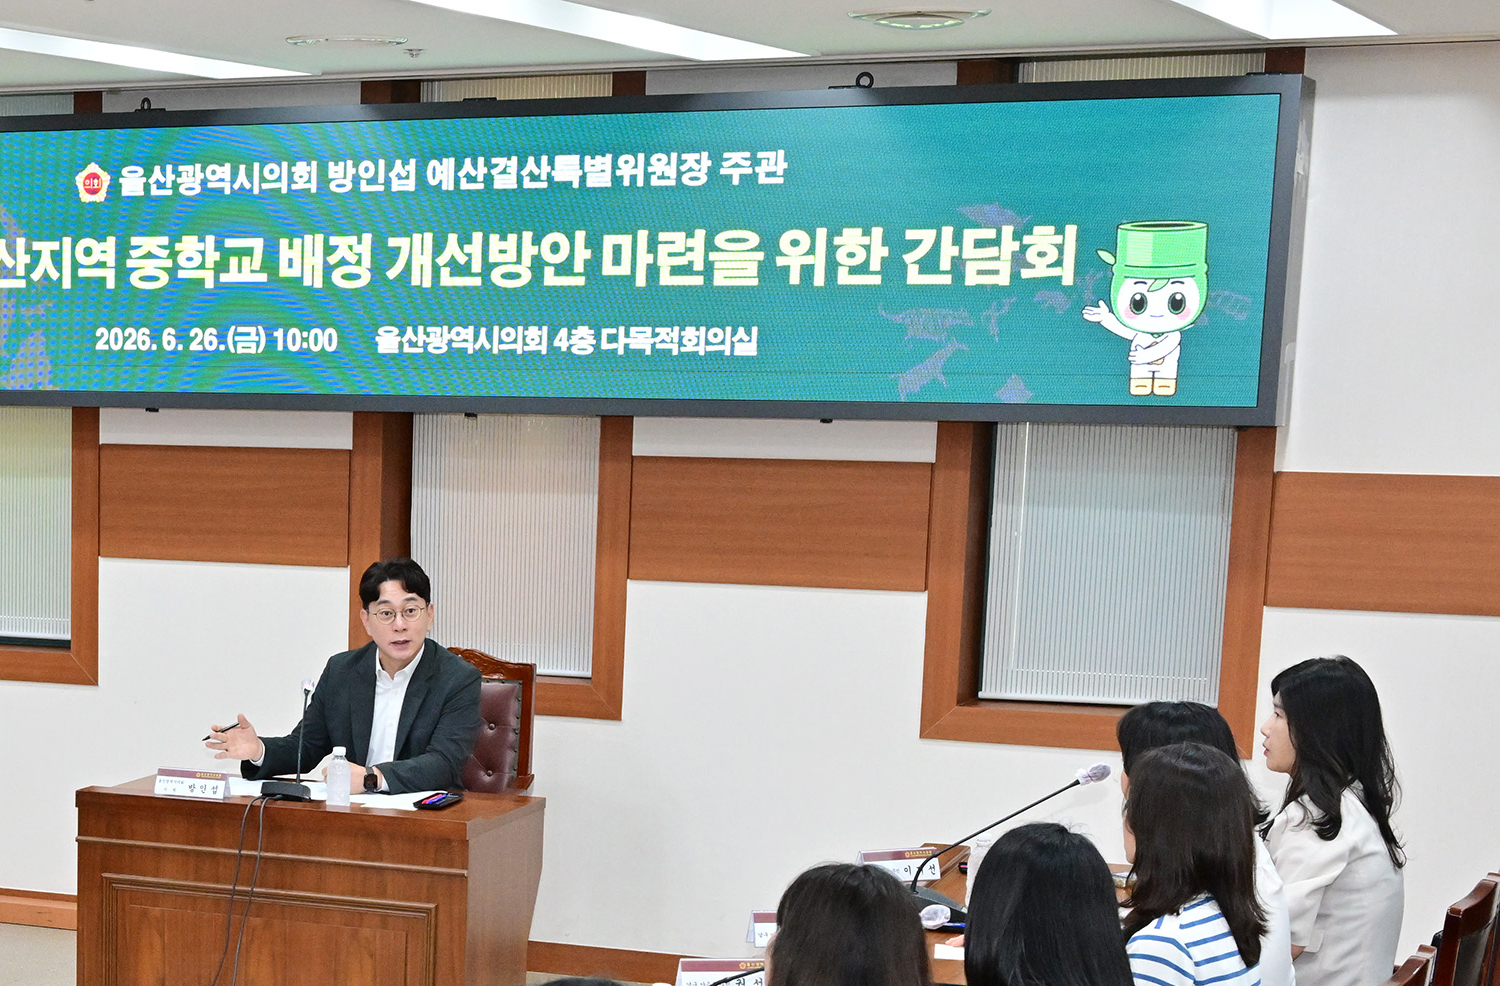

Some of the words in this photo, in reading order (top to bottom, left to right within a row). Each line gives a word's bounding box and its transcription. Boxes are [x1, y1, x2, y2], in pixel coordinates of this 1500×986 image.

[119, 161, 317, 197] 울산광역시의회
[327, 158, 416, 193] 방인섭
[426, 151, 712, 191] 예산결산특별위원장
[719, 150, 788, 186] 주관
[126, 235, 268, 290] 중학교
[279, 233, 373, 289] 배정
[386, 230, 591, 289] 개선방안
[603, 228, 765, 288] 마련을
[775, 226, 889, 286] 위한
[901, 224, 1078, 286] 간담회
[95, 327, 157, 351] 2026.
[162, 327, 183, 351] 6.
[189, 325, 267, 354] 26.(금)
[273, 328, 338, 352] 10:00
[375, 326, 548, 355] 울산광역시의회
[554, 327, 597, 355] 4층
[601, 325, 758, 356] 다목적회의실
